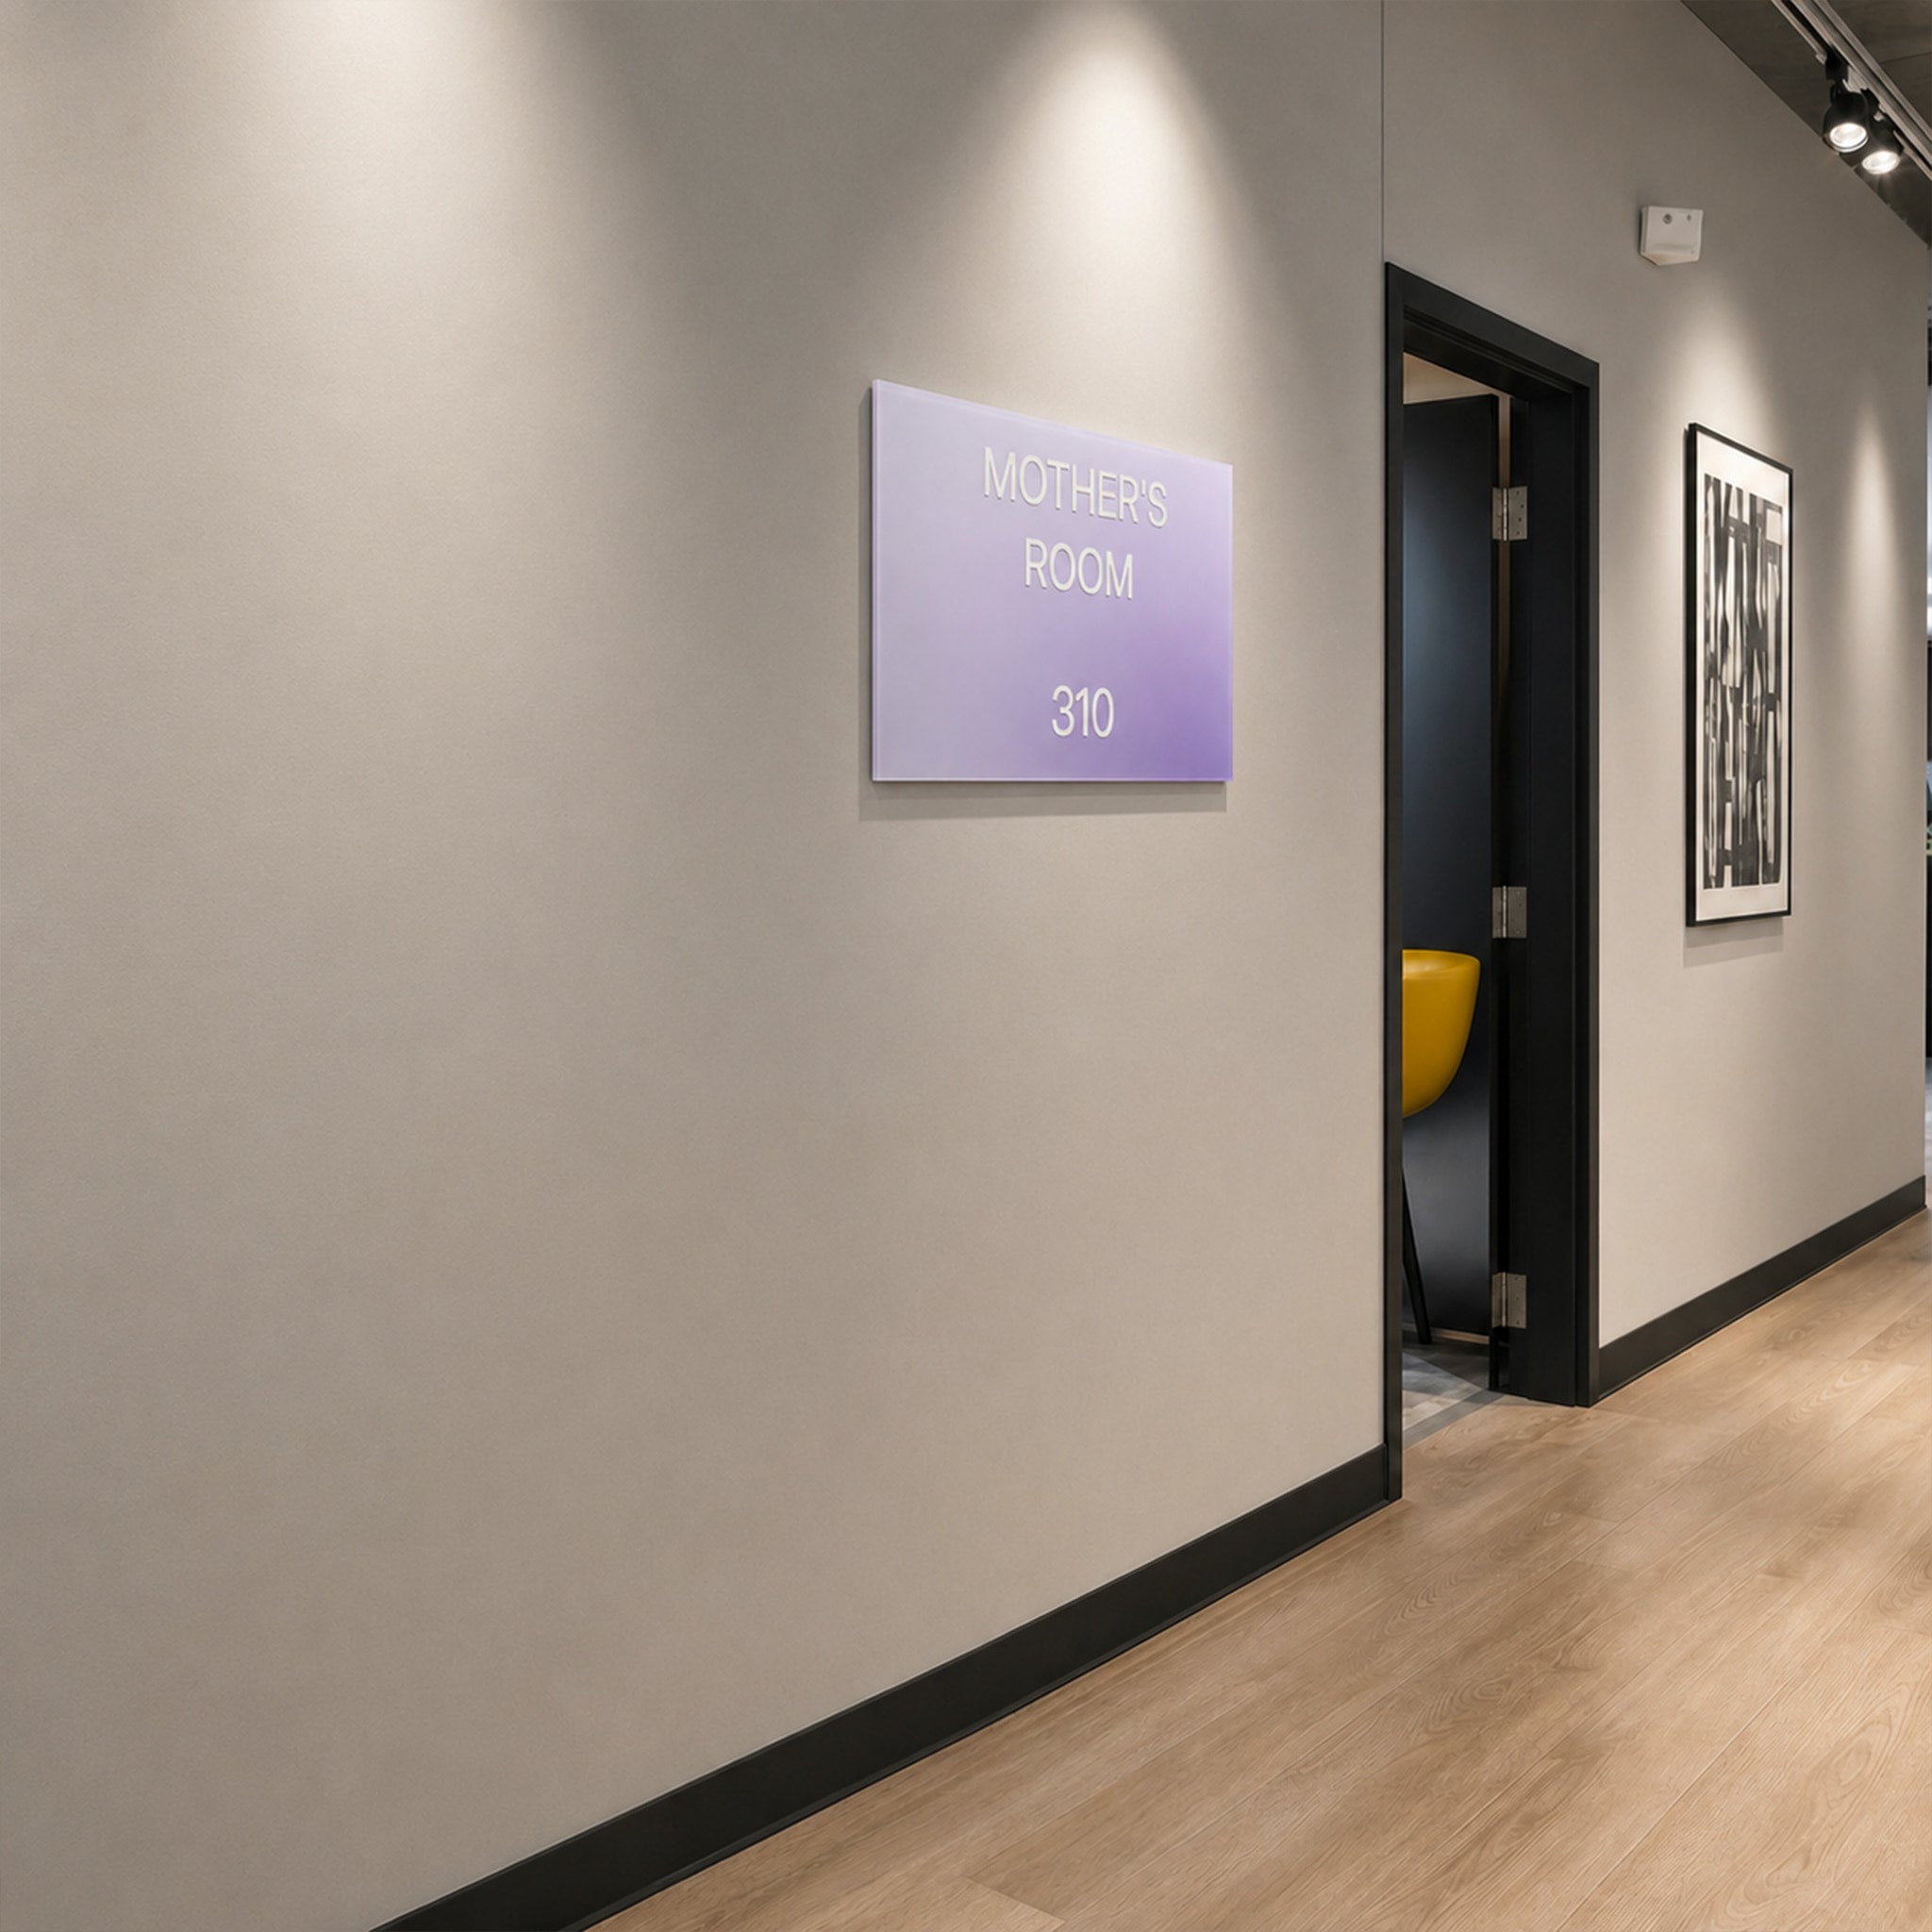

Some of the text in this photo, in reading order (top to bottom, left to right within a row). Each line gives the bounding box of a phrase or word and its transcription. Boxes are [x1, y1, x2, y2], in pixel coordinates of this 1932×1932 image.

[983, 446, 1168, 528] MOTHER'S
[1024, 537, 1133, 599] ROOM
[1051, 685, 1115, 738] 310
